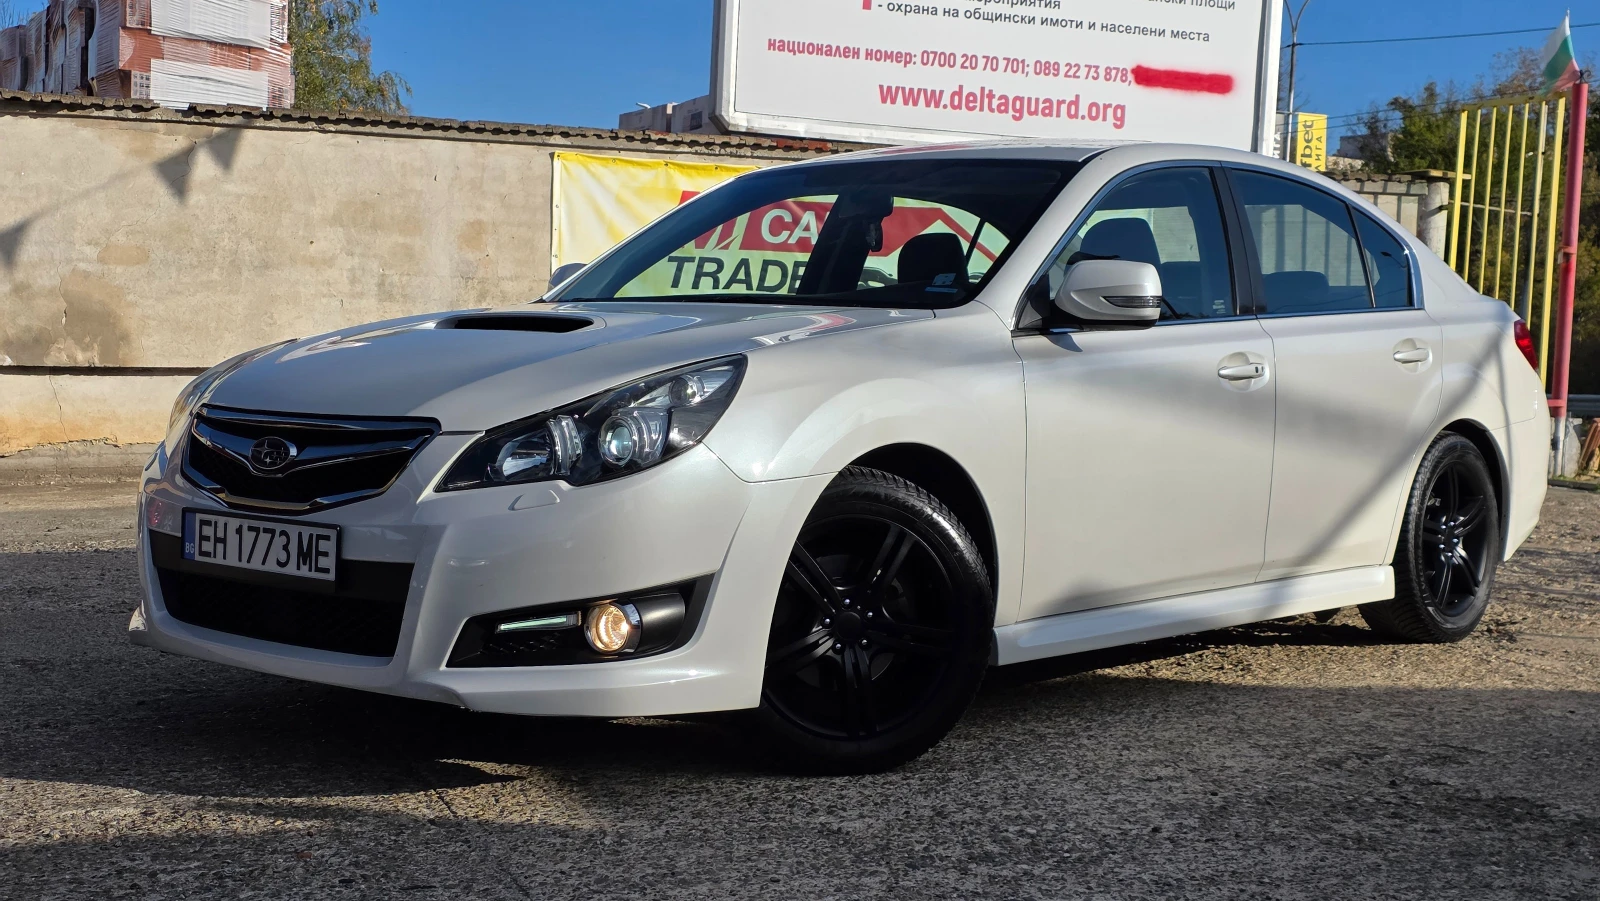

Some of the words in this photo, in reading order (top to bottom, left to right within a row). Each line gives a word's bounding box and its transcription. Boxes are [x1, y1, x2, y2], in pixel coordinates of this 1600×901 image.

[886, 1, 938, 17] охрана
[942, 7, 959, 18] на
[963, 7, 1036, 25] общински
[1040, 15, 1084, 30] имоти
[1088, 20, 1096, 31] и
[1101, 22, 1166, 38] населени
[1170, 29, 1210, 42] места
[767, 38, 861, 60] национален
[864, 48, 917, 68] номер:
[920, 50, 957, 69] 0700
[960, 53, 979, 71] 20
[982, 55, 1000, 72] 70
[1002, 57, 1030, 77] 701;
[1033, 60, 1061, 77] 089
[1064, 62, 1081, 80] 22
[1084, 64, 1100, 81] 73
[1103, 66, 1133, 86] 878,
[878, 83, 1126, 130] www.deltaguard.org
[1301, 120, 1314, 168] fbet
[761, 208, 829, 245] CA
[667, 255, 809, 295] TRADE
[185, 541, 195, 554] BG
[198, 519, 228, 561] EH
[235, 524, 291, 568] 1773
[296, 531, 331, 574] ME
